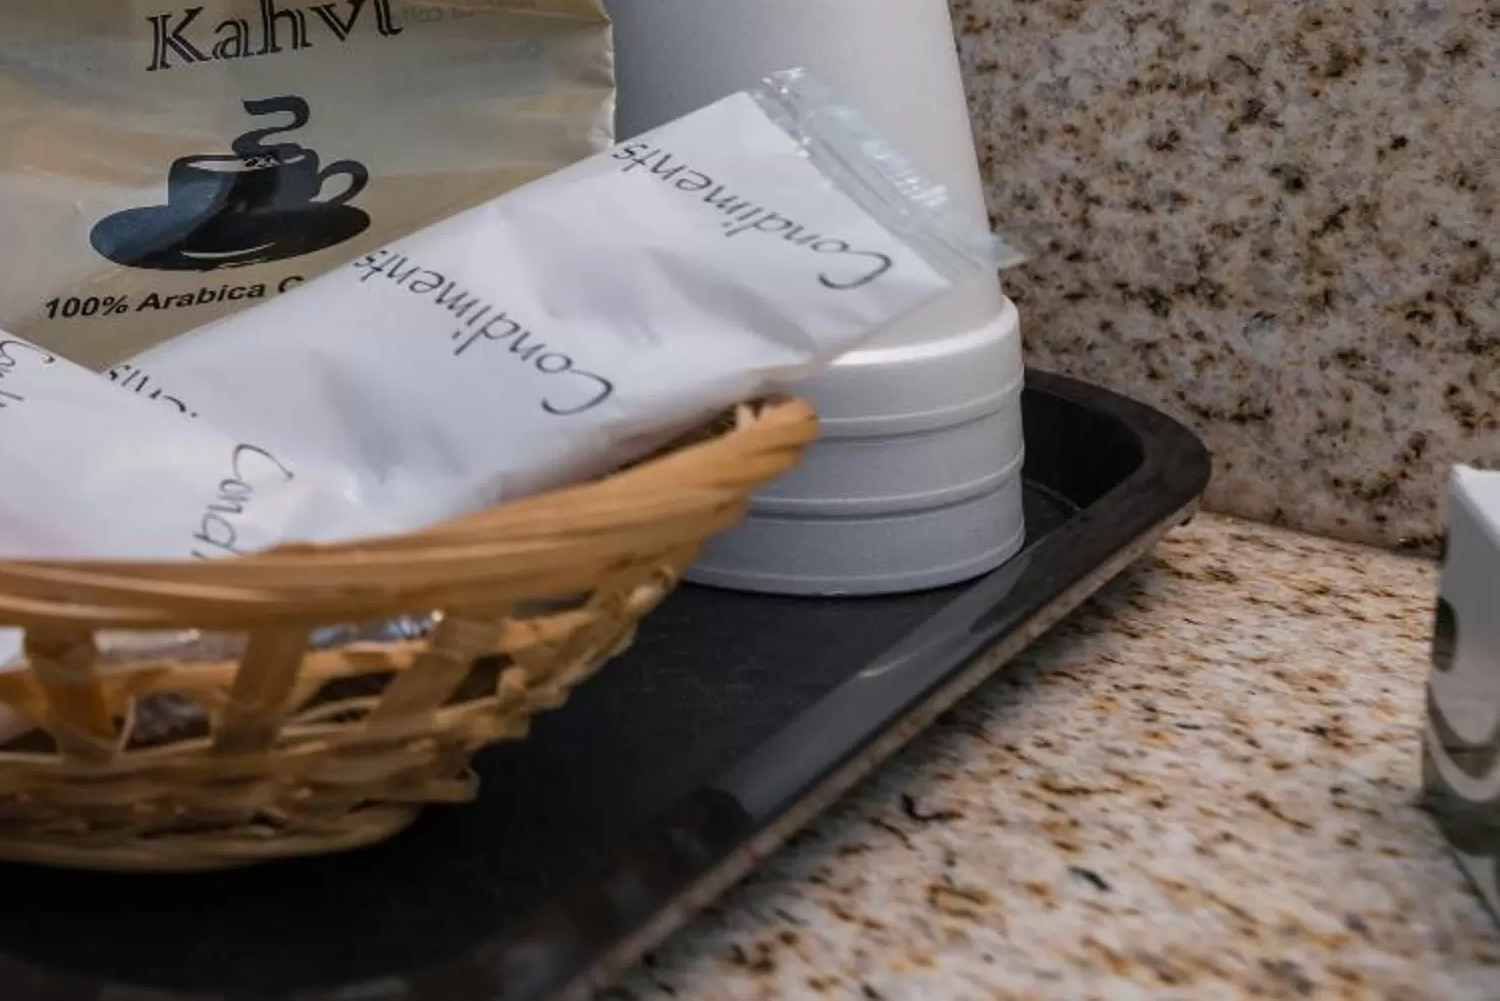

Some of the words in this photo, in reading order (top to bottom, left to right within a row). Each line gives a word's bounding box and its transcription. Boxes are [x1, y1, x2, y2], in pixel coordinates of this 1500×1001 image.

[611, 143, 893, 291] Condiments
[46, 295, 129, 320] 100%
[135, 281, 267, 313] Arabica
